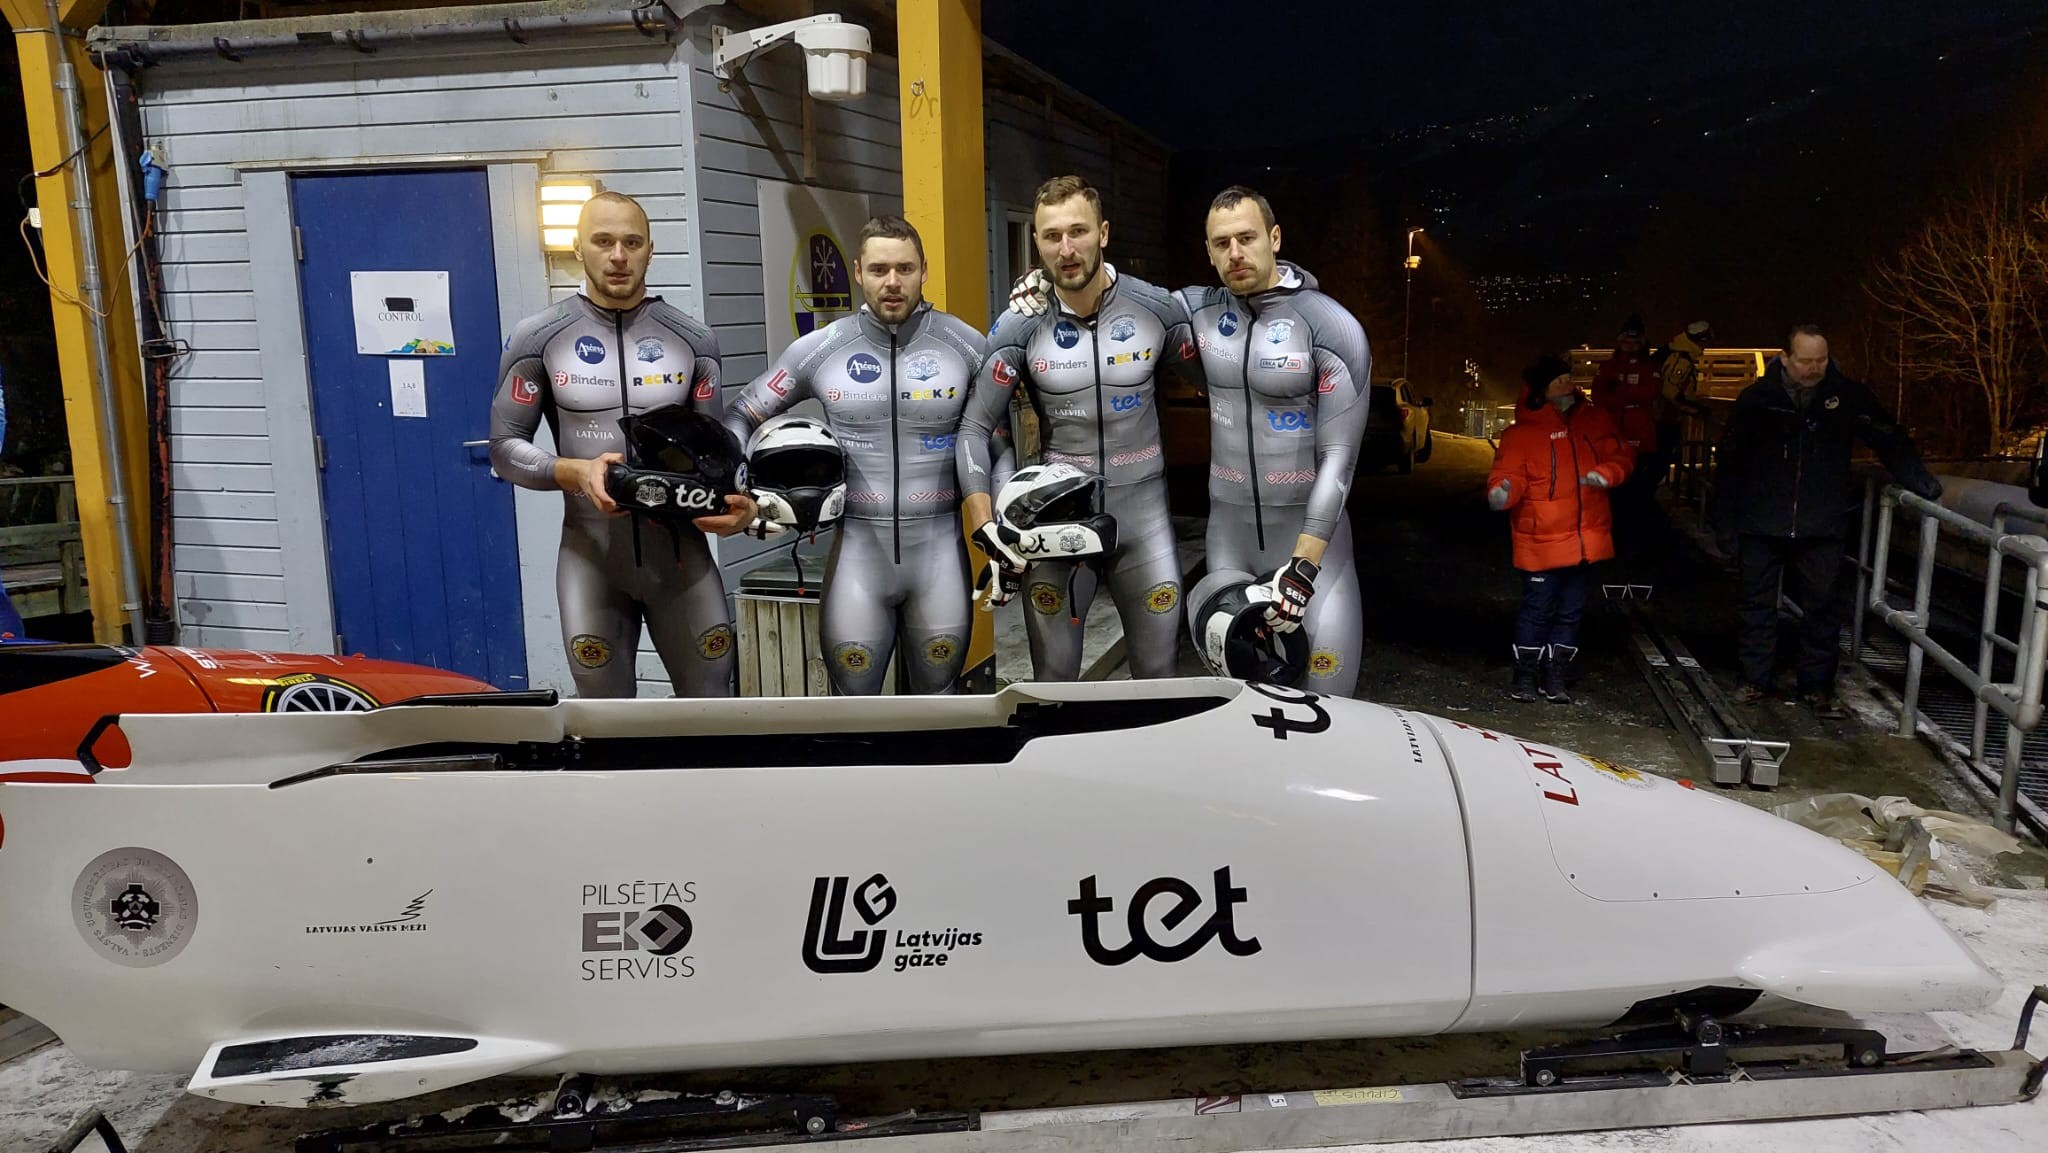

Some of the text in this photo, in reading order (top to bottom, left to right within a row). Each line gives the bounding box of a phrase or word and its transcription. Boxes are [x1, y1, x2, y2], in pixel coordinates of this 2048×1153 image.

[378, 311, 424, 322] CONTROL
[1049, 360, 1089, 370] Binders
[570, 374, 616, 387] Binders
[1110, 391, 1143, 413] tet
[1266, 409, 1312, 432] tet
[576, 429, 615, 440] LATVIJA
[675, 484, 716, 510] tet
[581, 880, 697, 906] PILSĒTAS
[1066, 865, 1263, 967] tet
[305, 925, 357, 934] LATVIJAS
[359, 924, 398, 932] VALSTS
[894, 928, 983, 950] Latvijas
[581, 955, 696, 982] SERVISS
[894, 950, 949, 972] gāze
